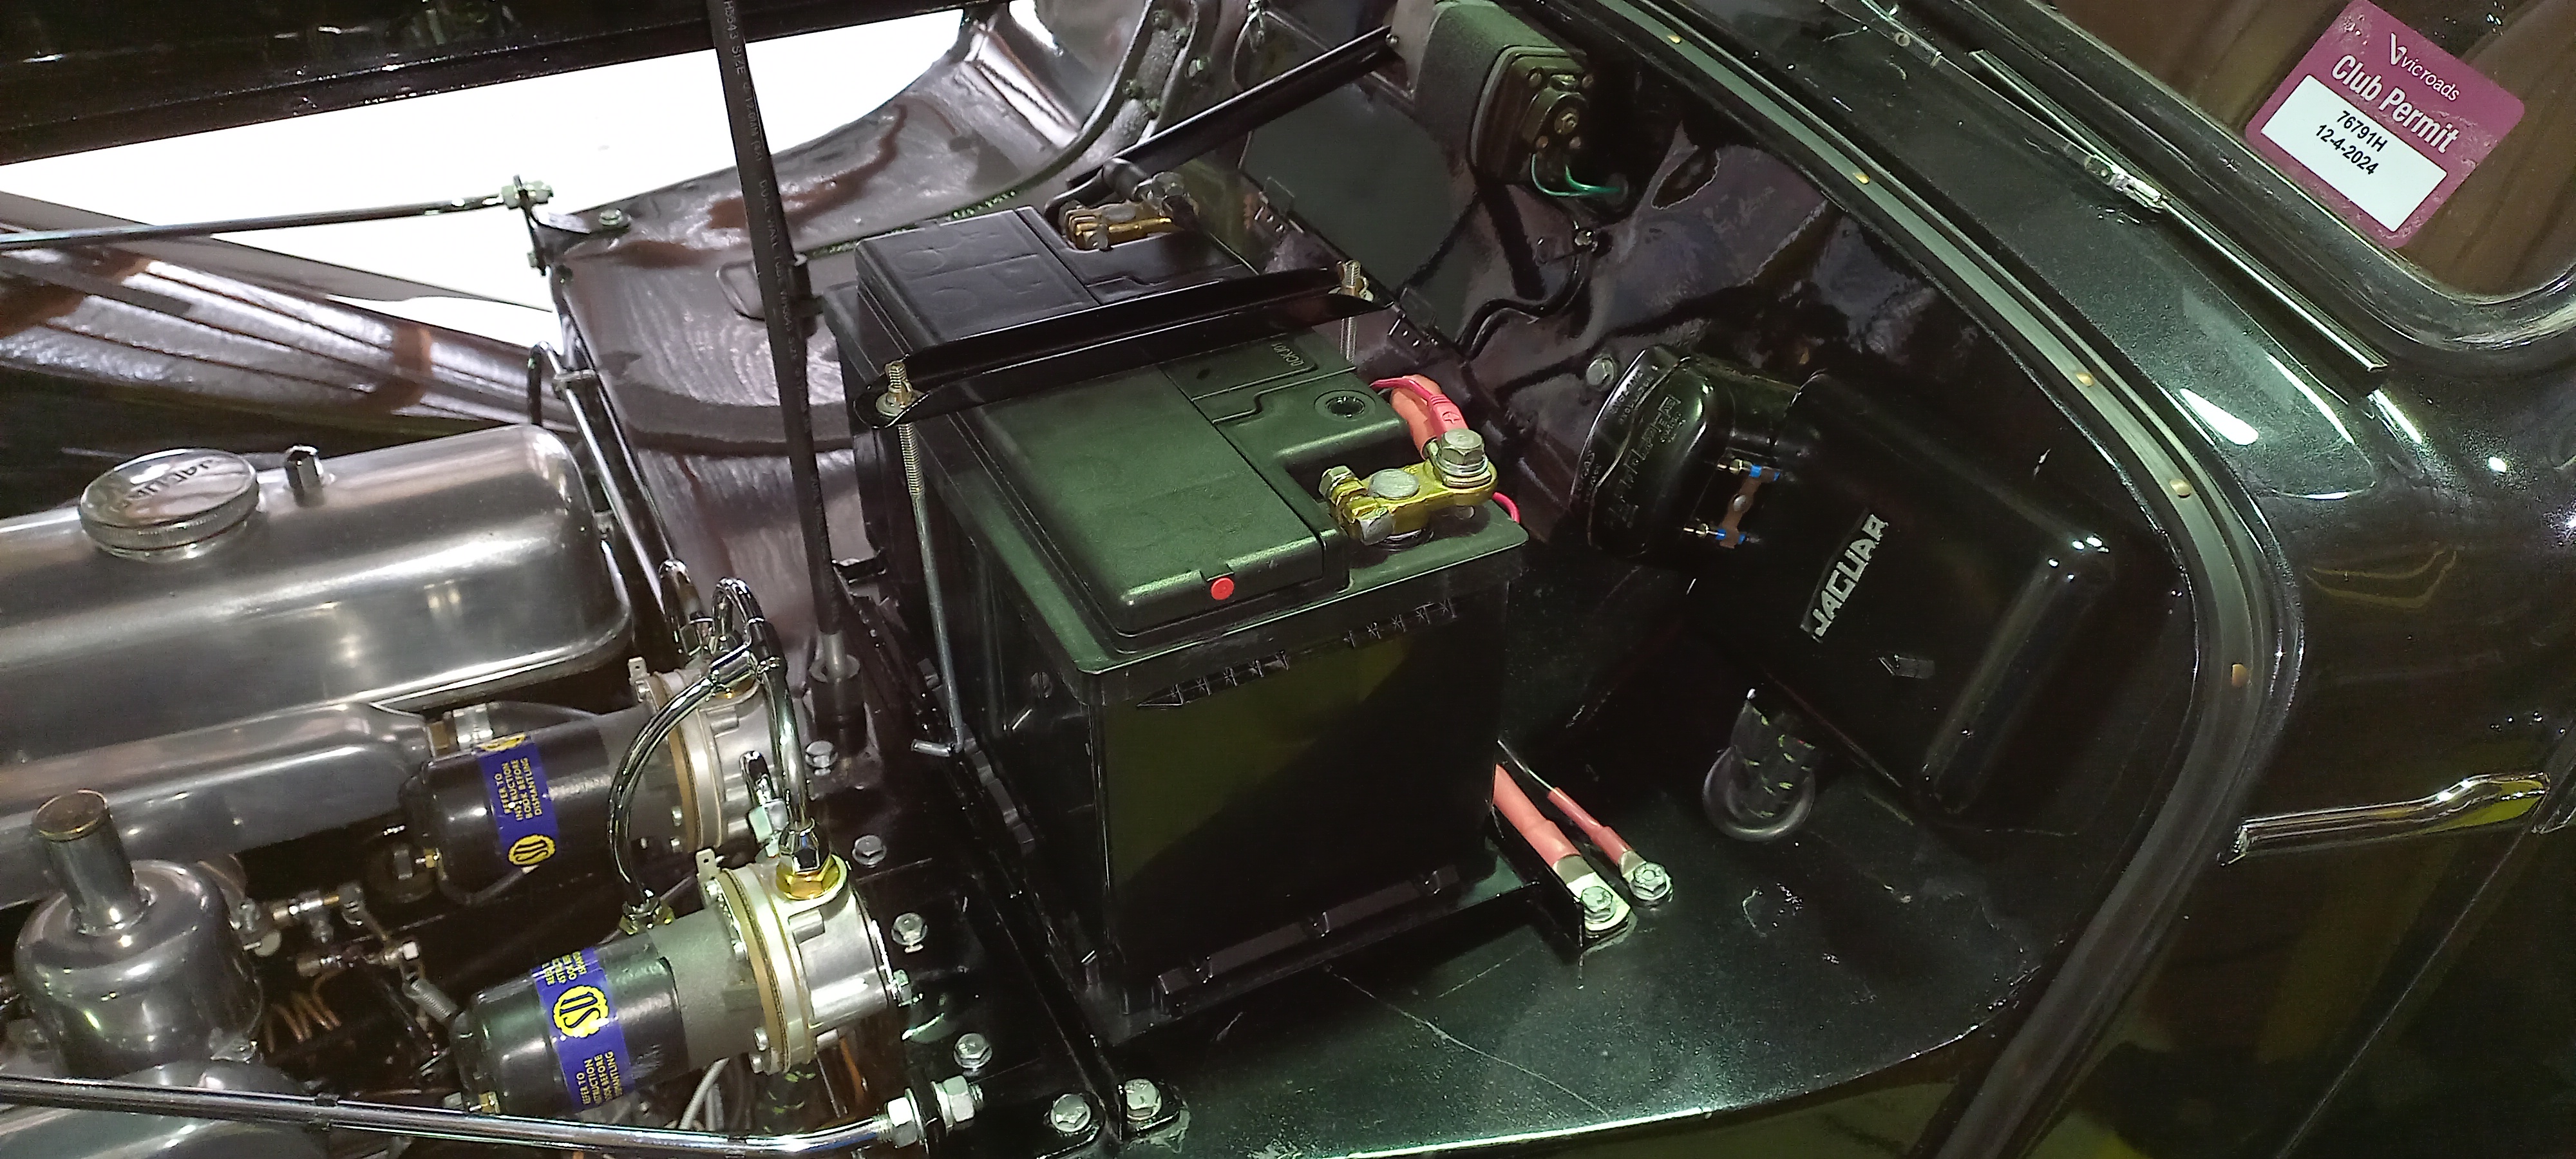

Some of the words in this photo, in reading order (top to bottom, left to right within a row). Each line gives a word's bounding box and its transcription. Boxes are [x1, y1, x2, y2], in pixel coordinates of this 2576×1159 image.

[2401, 57, 2460, 102] vicroads
[2331, 54, 2383, 102] Club
[2378, 86, 2460, 155] Permit
[2316, 124, 2380, 176] 12-4-2024
[2336, 110, 2388, 153] 76791H
[1812, 514, 1889, 637] JAGUAR
[494, 773, 504, 786] TO
[511, 760, 527, 790] BEFORE
[520, 758, 542, 816] DISMANTLING
[520, 793, 533, 818] BOOK
[577, 1072, 585, 1084] TO
[585, 1059, 608, 1105] TRUCTION
[594, 1055, 610, 1086] BEFORE
